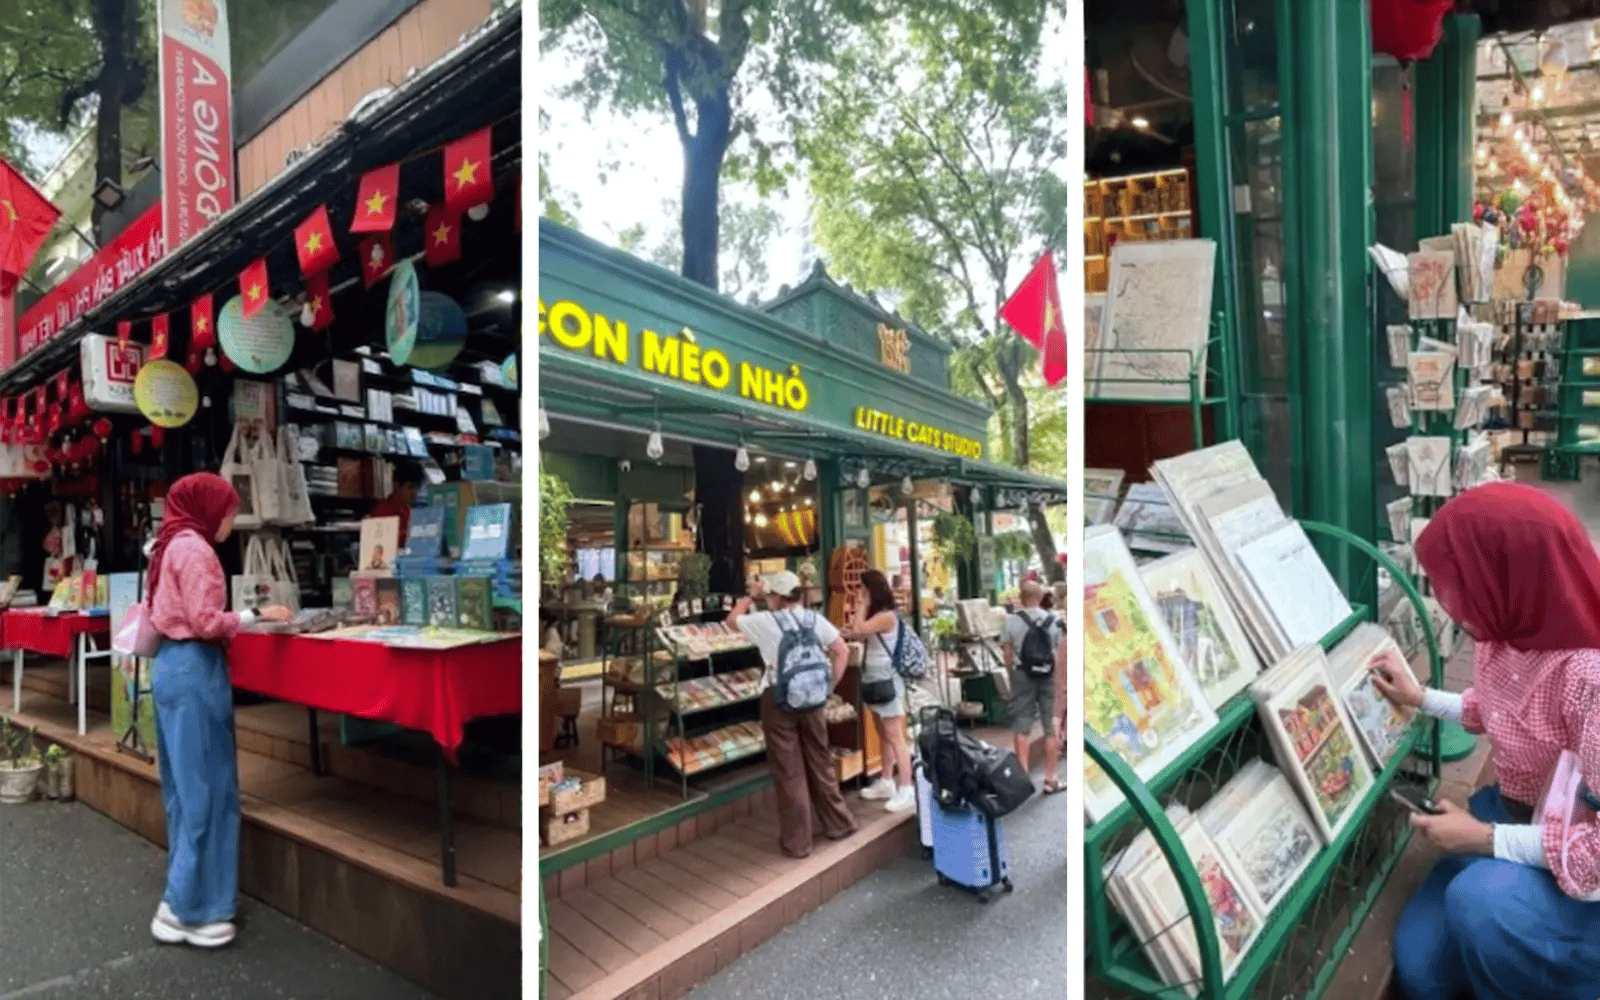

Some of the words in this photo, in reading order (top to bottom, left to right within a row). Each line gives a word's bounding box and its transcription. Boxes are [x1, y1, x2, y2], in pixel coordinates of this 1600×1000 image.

[538, 296, 630, 364] ON
[641, 327, 731, 390] MÈO
[737, 362, 809, 411] NHỎ
[855, 406, 905, 440] LITTLE
[907, 421, 941, 448] CATS
[942, 432, 982, 460] STUDIO
